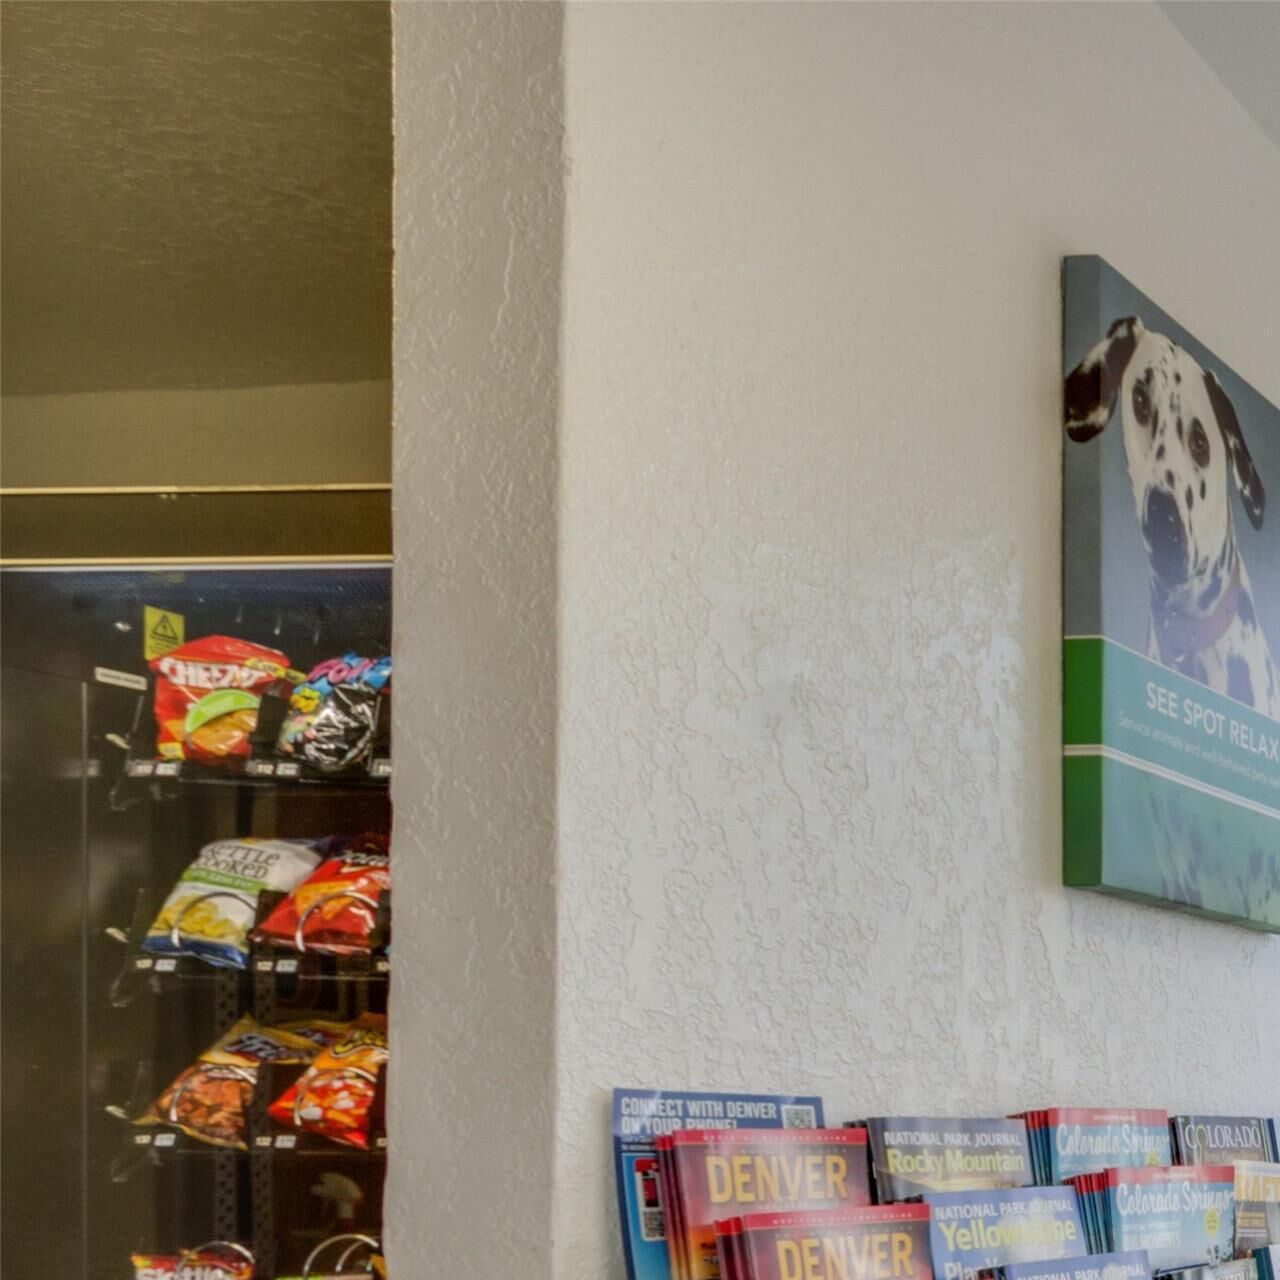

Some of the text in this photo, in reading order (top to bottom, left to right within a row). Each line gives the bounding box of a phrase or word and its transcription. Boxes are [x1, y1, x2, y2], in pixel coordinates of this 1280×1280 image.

[1146, 682, 1280, 762] SEE SPOT RELAX
[621, 1097, 777, 1119] CONNECT WITH DENVER
[621, 1117, 640, 1134] ON
[641, 1118, 682, 1134] YOUR
[884, 1131, 1022, 1147] NATIONAL PARK JOURNAL
[1185, 1123, 1261, 1149] COLORADO
[886, 1148, 1025, 1179] Rocky Mountain
[705, 1154, 849, 1203] DENVER
[935, 1204, 997, 1220] NATIONAL
[1000, 1202, 1025, 1215] PARK
[1116, 1183, 1181, 1216] Colorado
[938, 1218, 1077, 1252] Yellowstone
